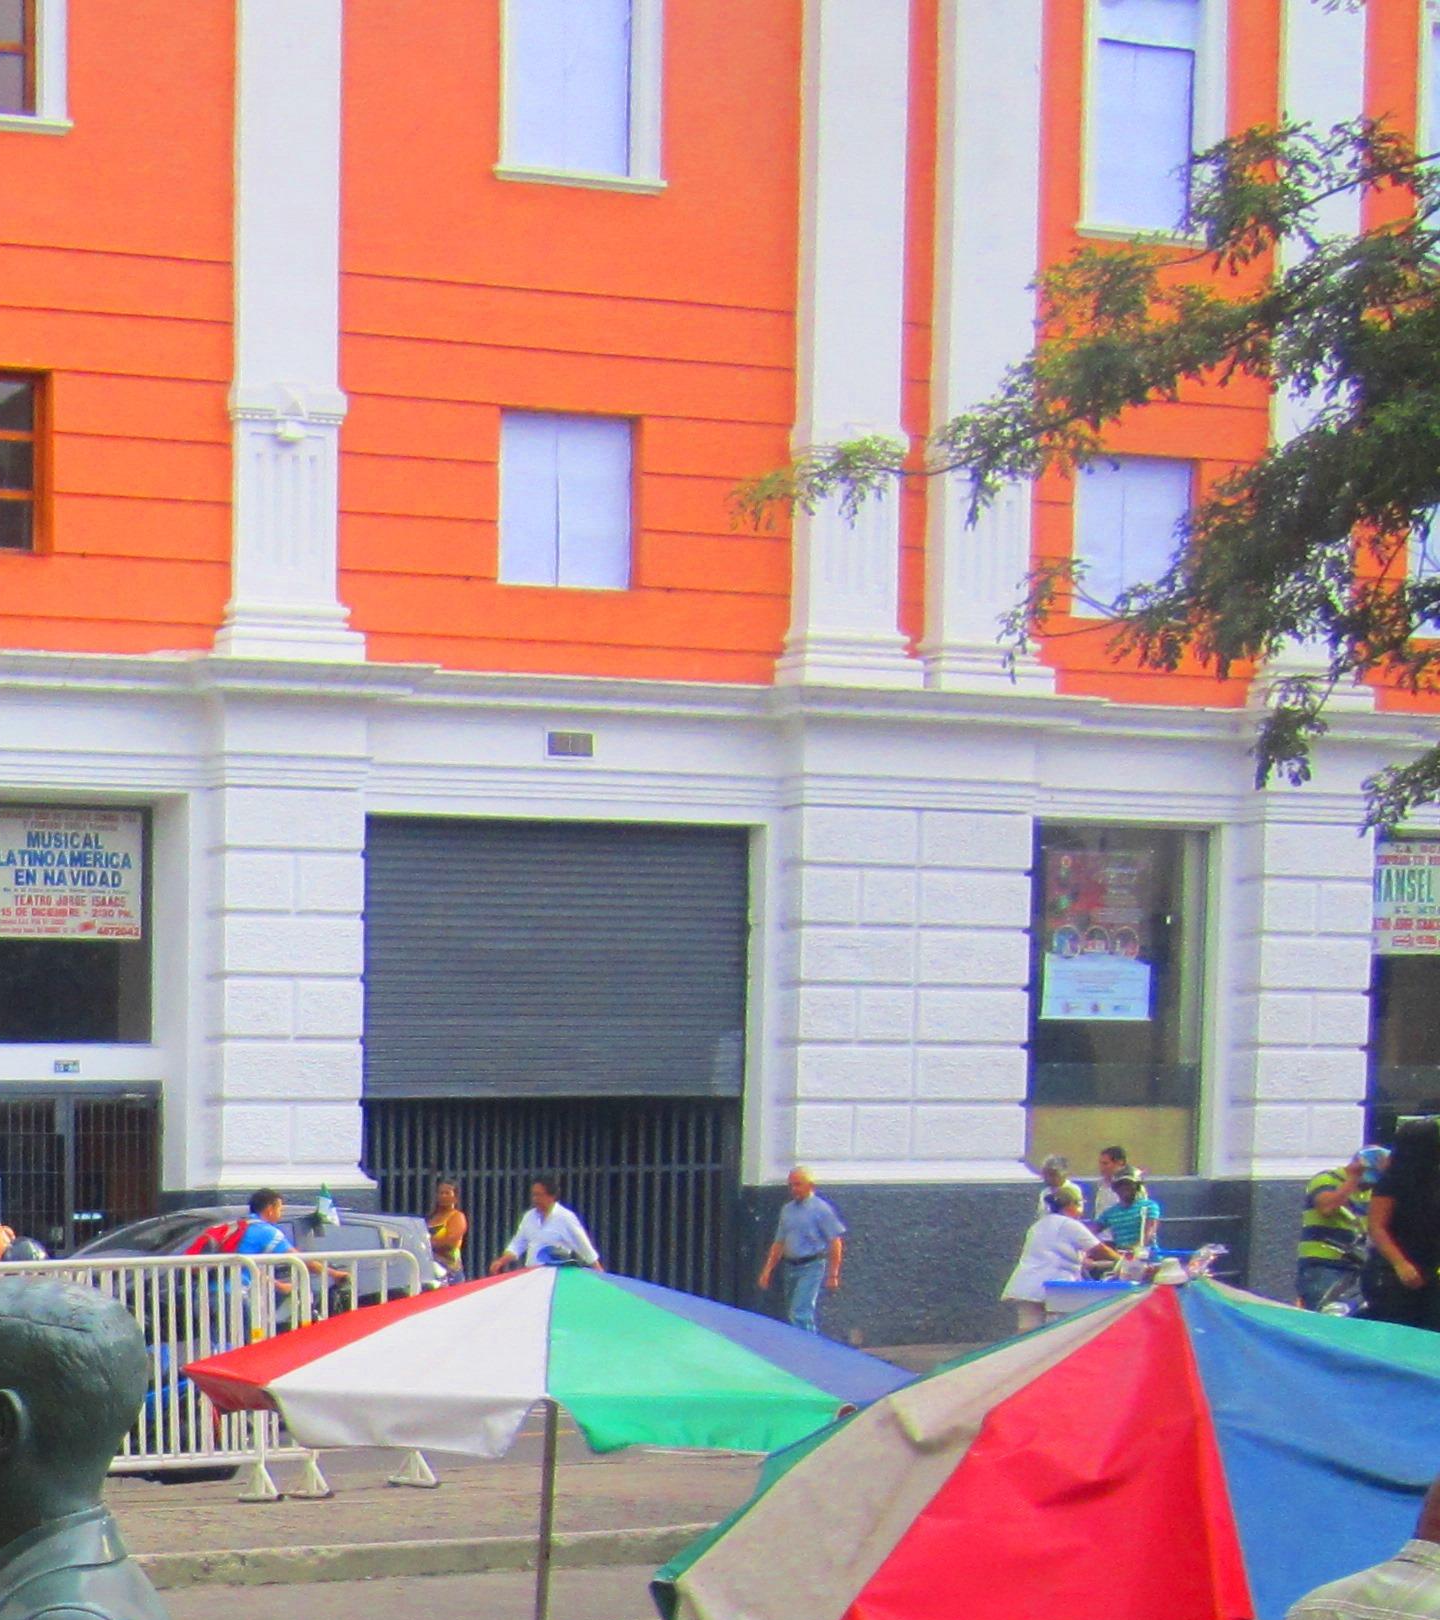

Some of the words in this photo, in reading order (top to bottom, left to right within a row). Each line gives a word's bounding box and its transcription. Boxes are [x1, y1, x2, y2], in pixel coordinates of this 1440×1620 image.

[26, 832, 104, 849] MUSICAL
[14, 869, 37, 886] EN
[44, 869, 122, 887] NAVIDAD
[14, 895, 52, 906] TEATRO
